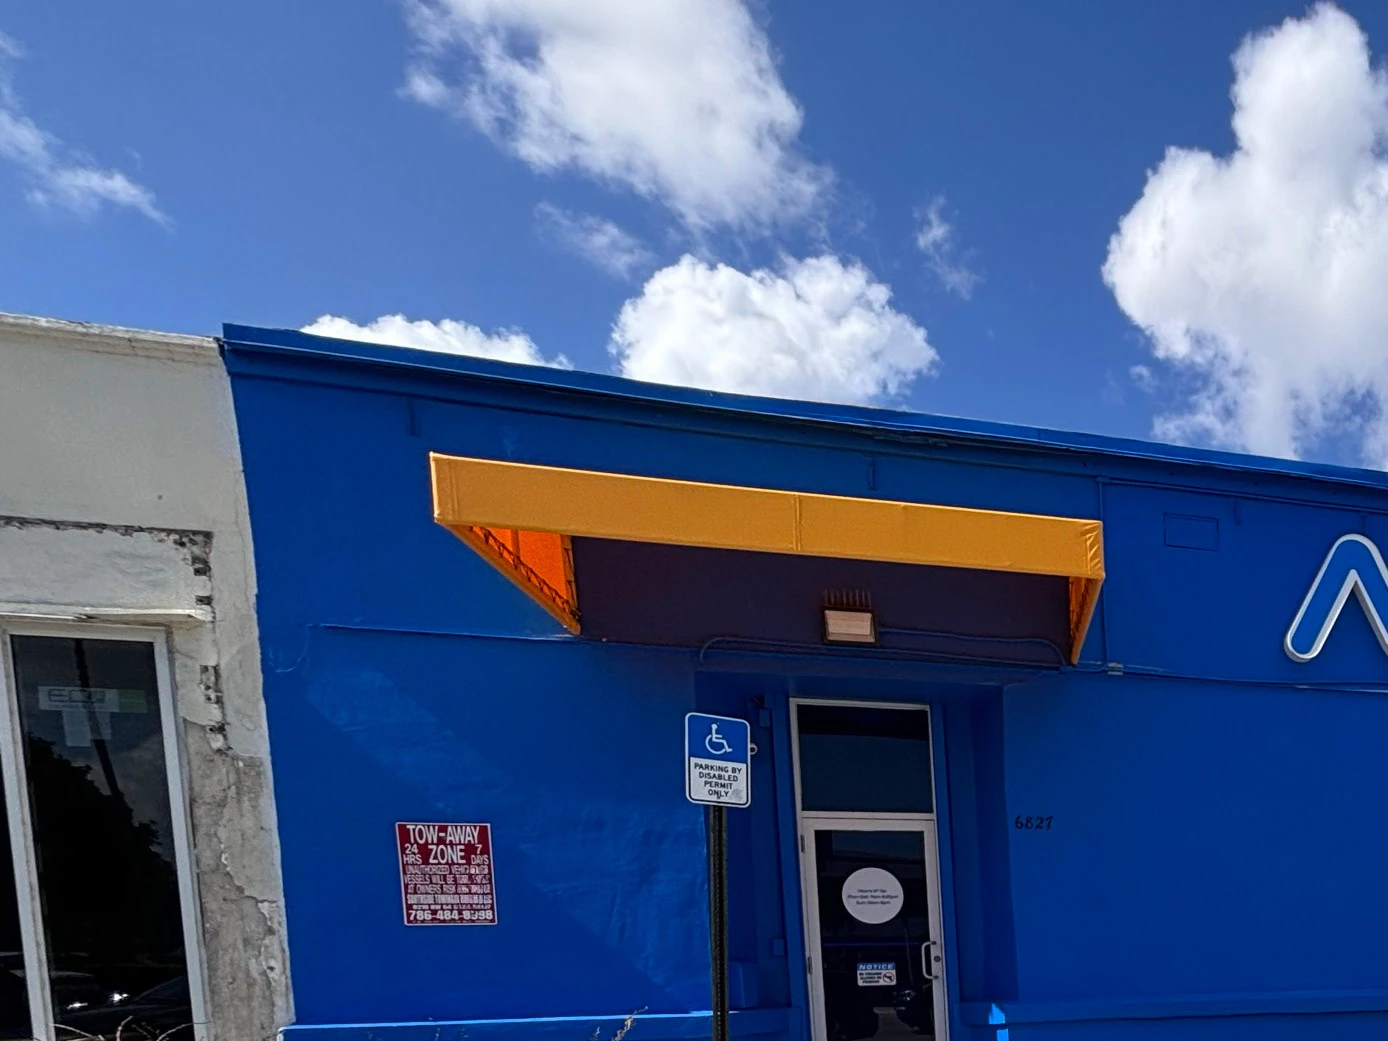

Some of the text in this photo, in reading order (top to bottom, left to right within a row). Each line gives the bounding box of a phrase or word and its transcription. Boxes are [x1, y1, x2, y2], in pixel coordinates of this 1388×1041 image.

[694, 762, 729, 773] PARKING
[699, 771, 738, 782] DISABLED
[704, 781, 733, 790] PERMIT
[708, 789, 729, 798] ONLY
[1015, 815, 1053, 830] 6827
[406, 825, 480, 844] TOW-AWAY
[404, 843, 419, 854] 24
[474, 844, 483, 854] 7
[403, 854, 422, 865] HRS
[428, 845, 466, 864] ZONE
[471, 855, 489, 865] DAYS
